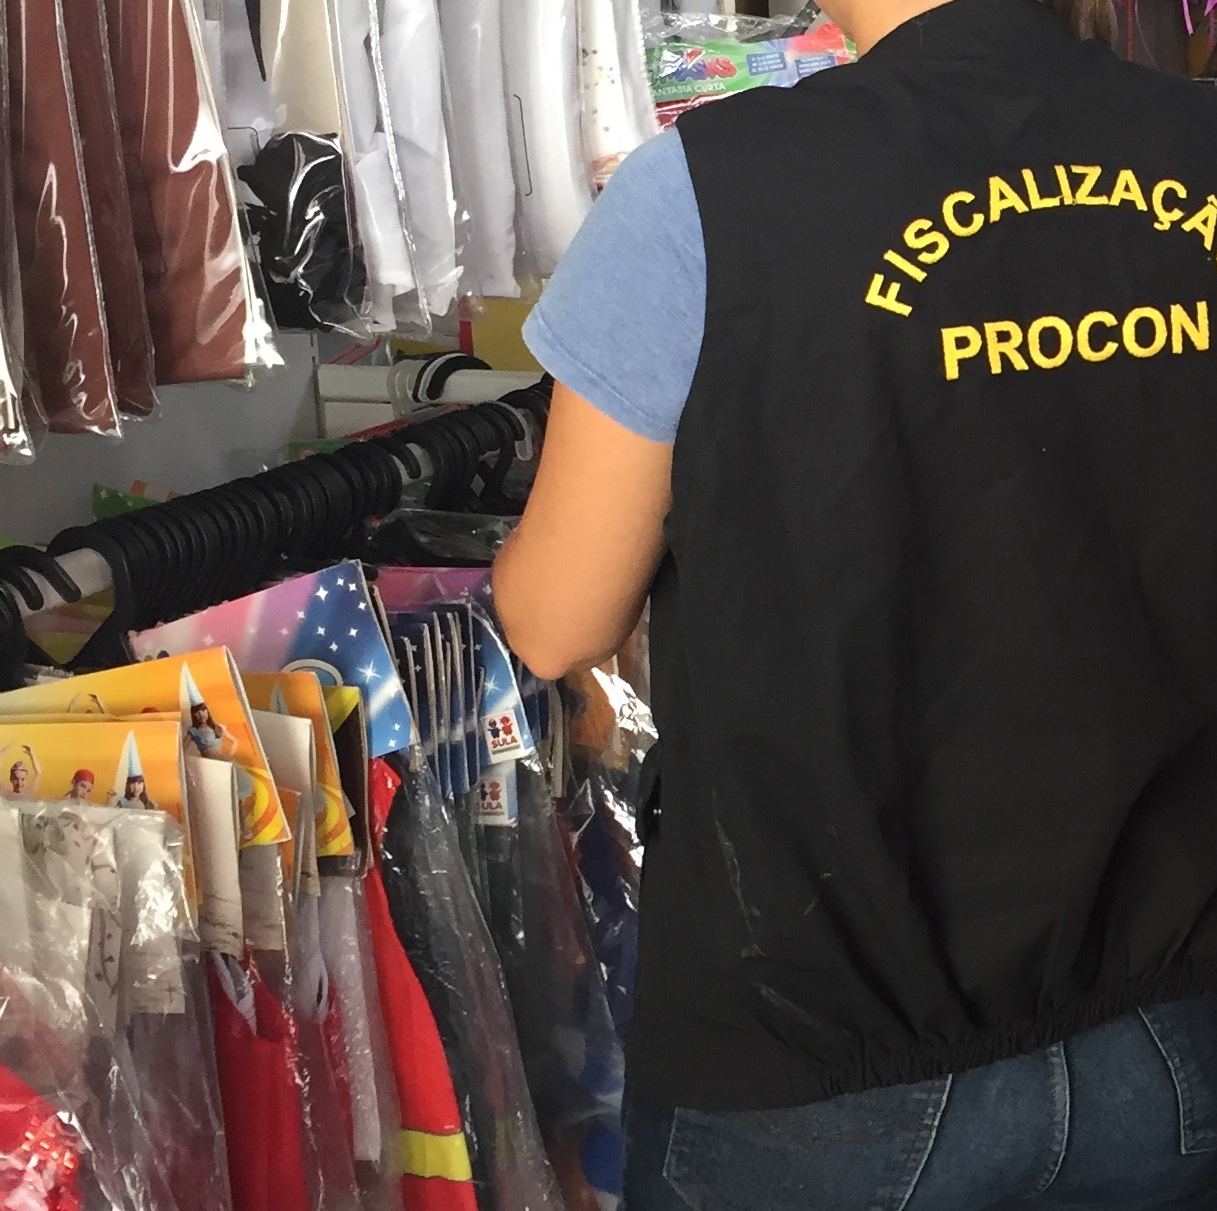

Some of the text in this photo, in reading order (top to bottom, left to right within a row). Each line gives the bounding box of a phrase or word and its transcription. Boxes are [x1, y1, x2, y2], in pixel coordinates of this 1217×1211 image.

[653, 82, 726, 96] ANTASIA CURTA
[940, 300, 1210, 380] PROCON
[491, 735, 518, 748] SULA
[480, 801, 503, 810] ULA
